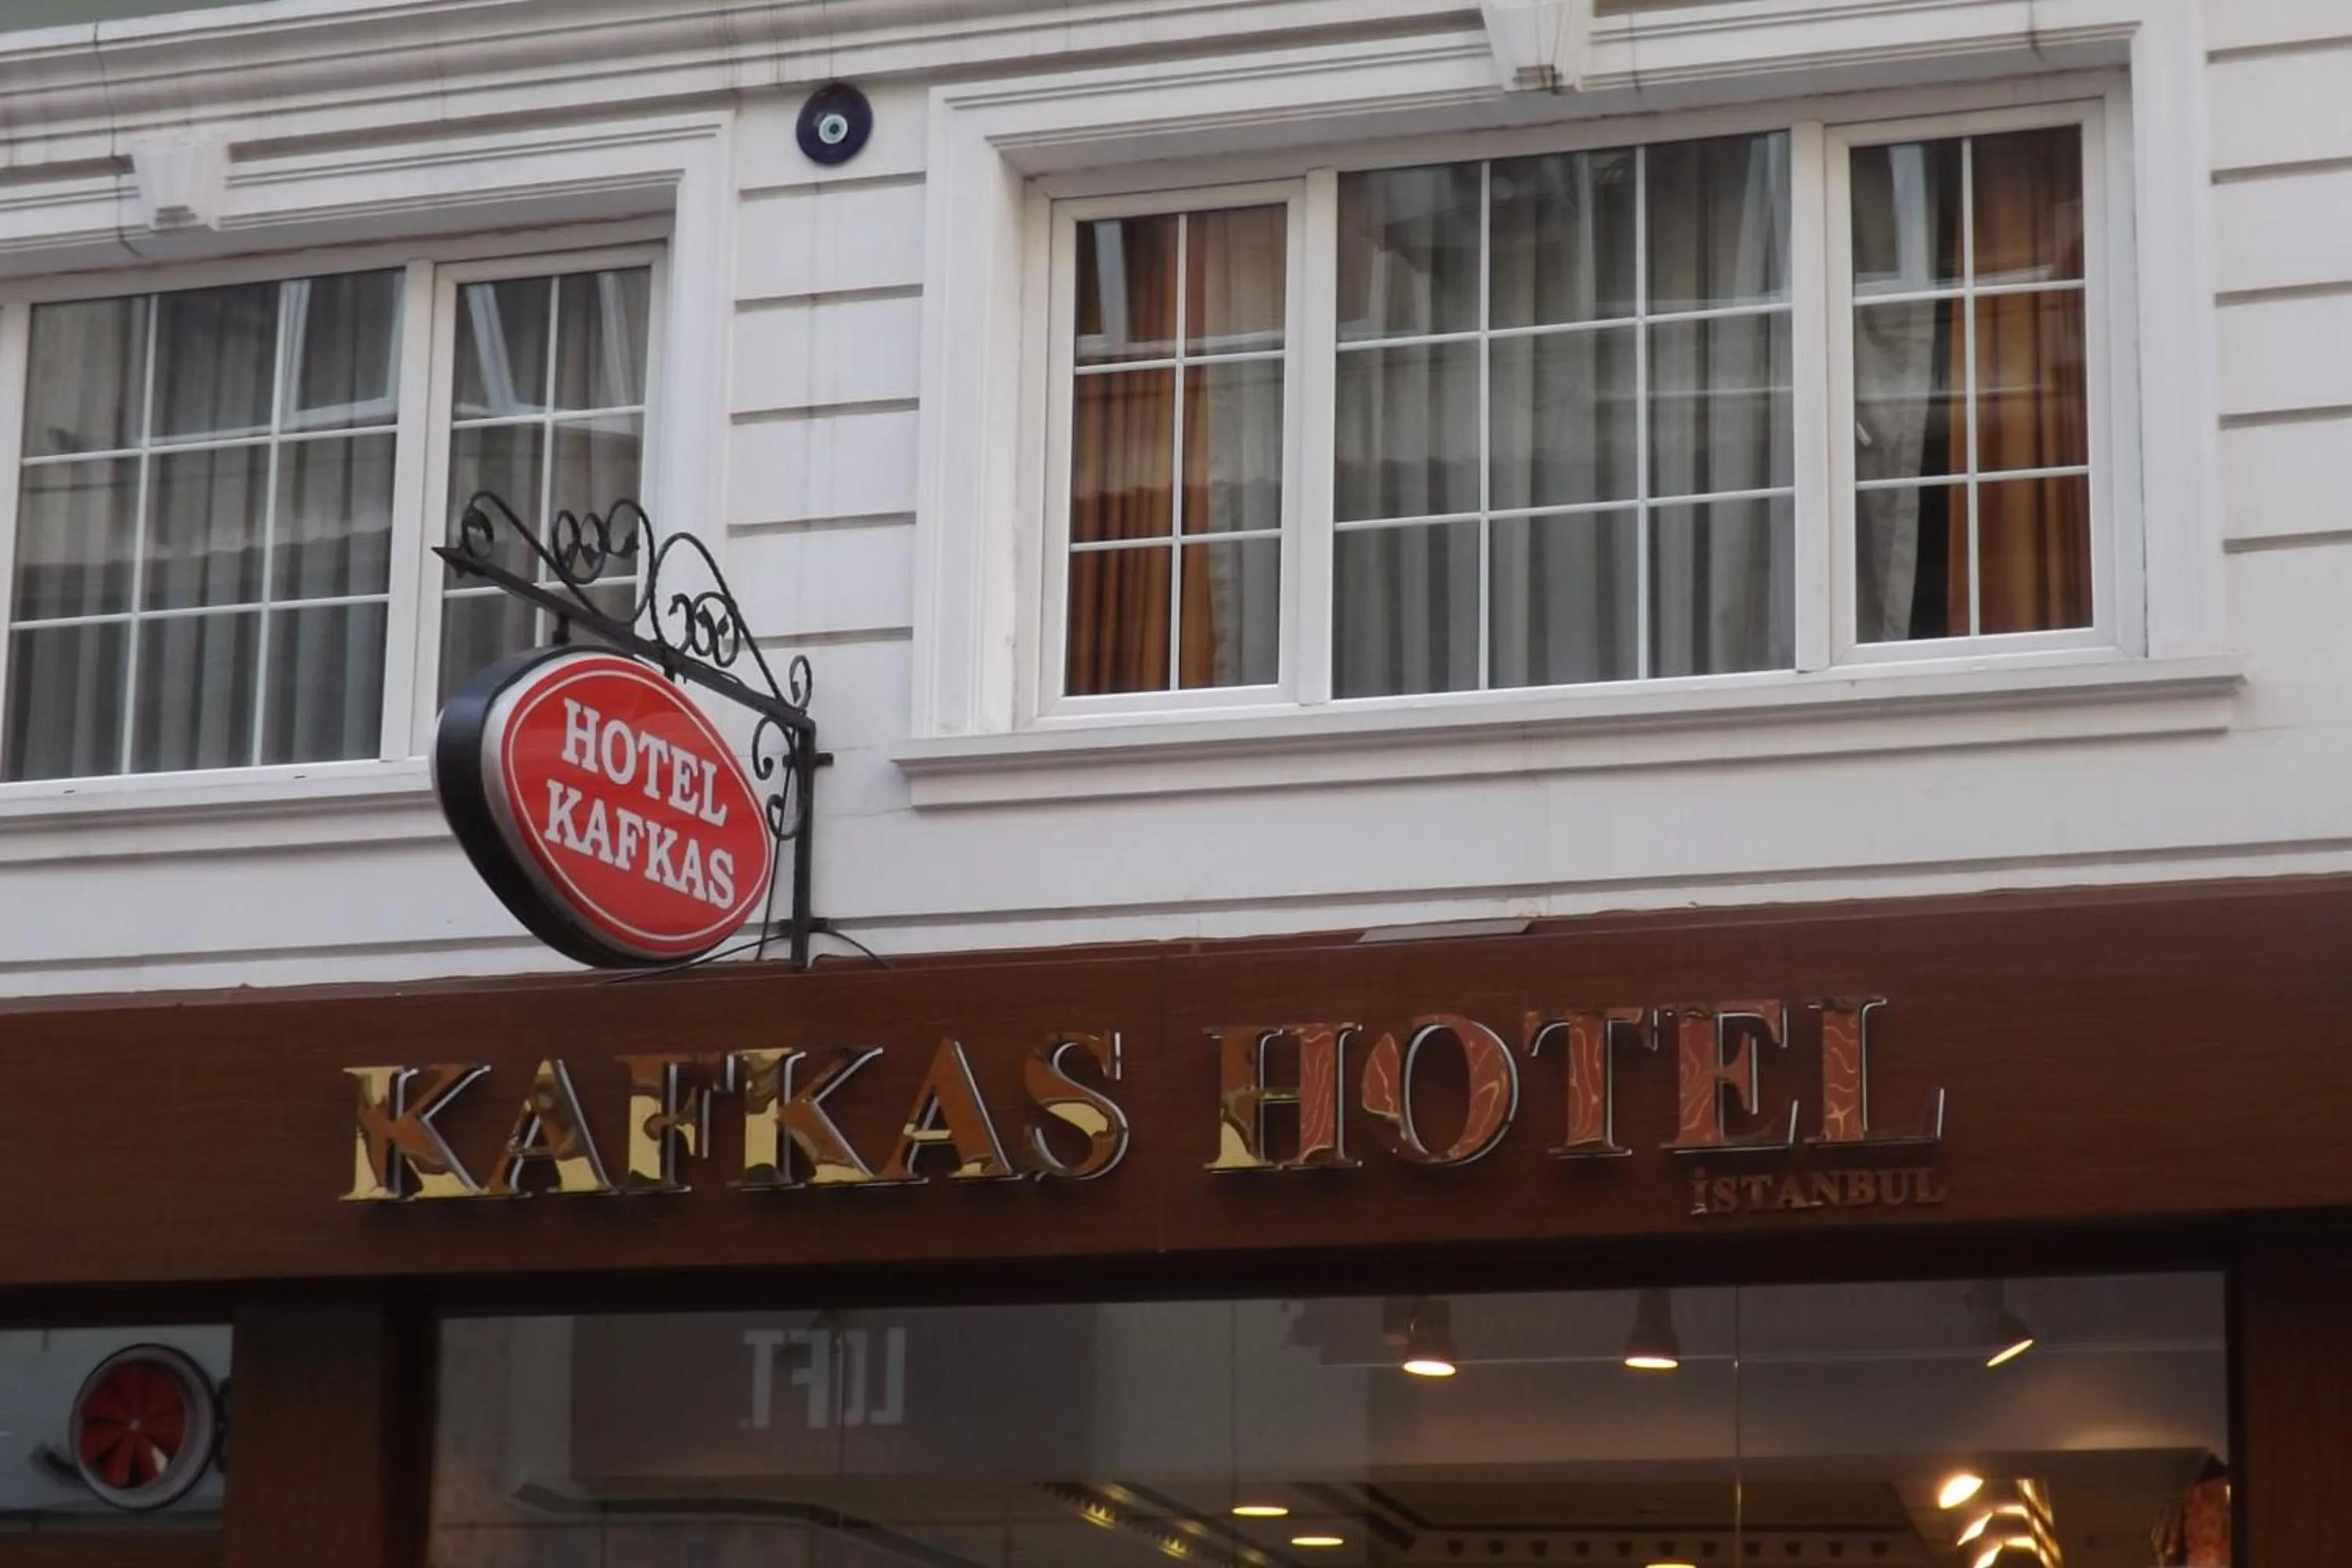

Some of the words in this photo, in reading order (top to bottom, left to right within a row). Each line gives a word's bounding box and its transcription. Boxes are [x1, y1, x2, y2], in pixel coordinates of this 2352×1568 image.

[561, 696, 728, 828] HOTEL
[544, 779, 735, 910] KAFKAS
[338, 1030, 1130, 1202] KAFKAS
[1202, 995, 1946, 1173] HOTEL
[1690, 1167, 1947, 1215] İSTANBUL
